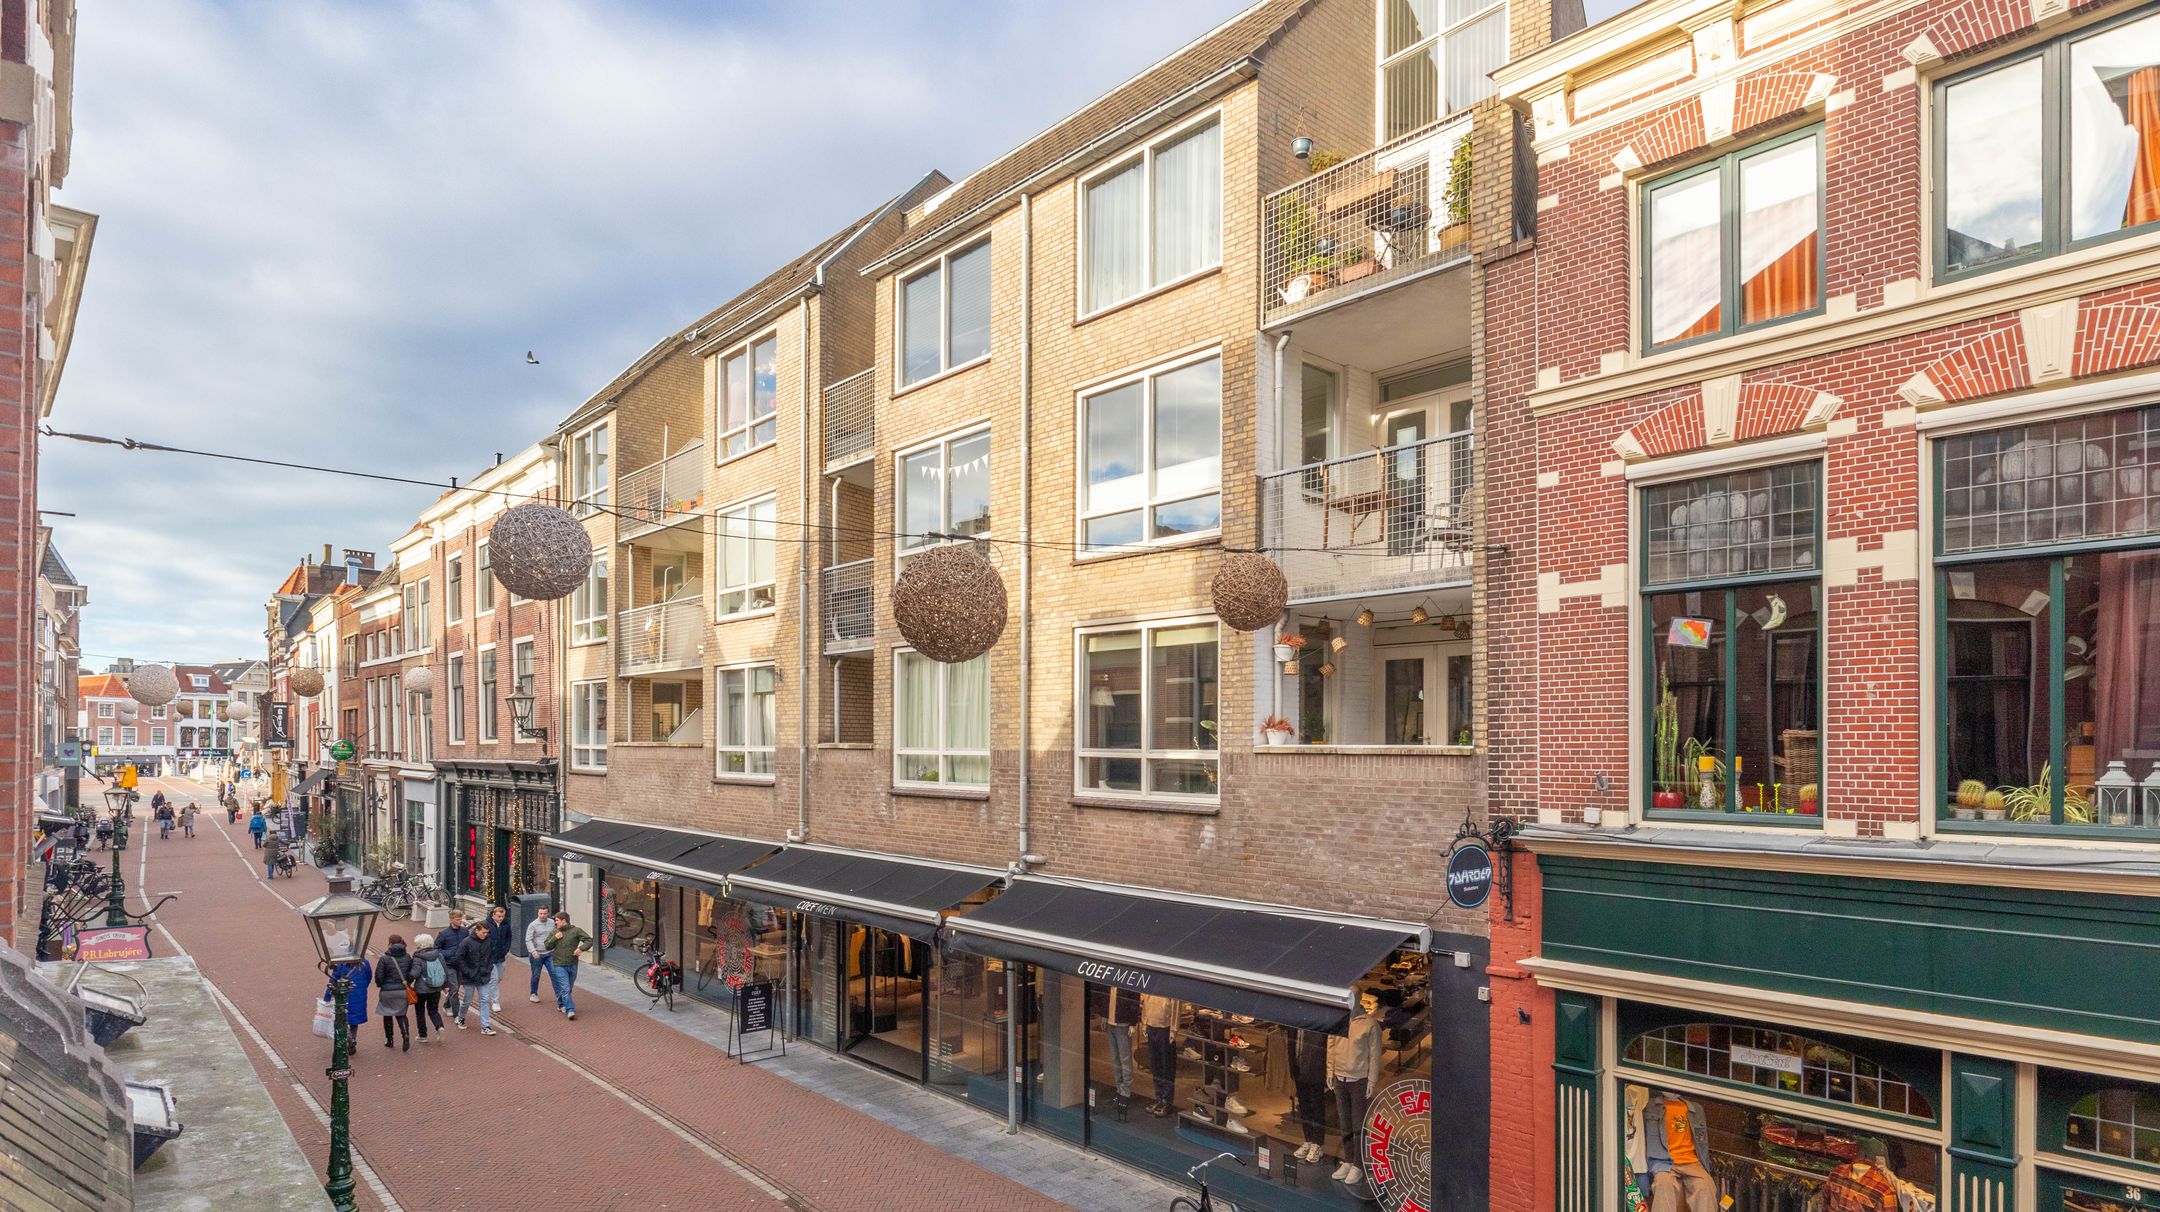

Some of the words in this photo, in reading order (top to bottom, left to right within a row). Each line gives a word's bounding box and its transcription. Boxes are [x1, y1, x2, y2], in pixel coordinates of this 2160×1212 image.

[646, 871, 663, 880] COEF
[797, 900, 819, 911] COEF
[815, 903, 838, 915] MEN
[1077, 961, 1114, 980] COEF
[1112, 968, 1151, 989] MEN
[1369, 1112, 1397, 1184] SALE
[2125, 1186, 2141, 1200] 36
